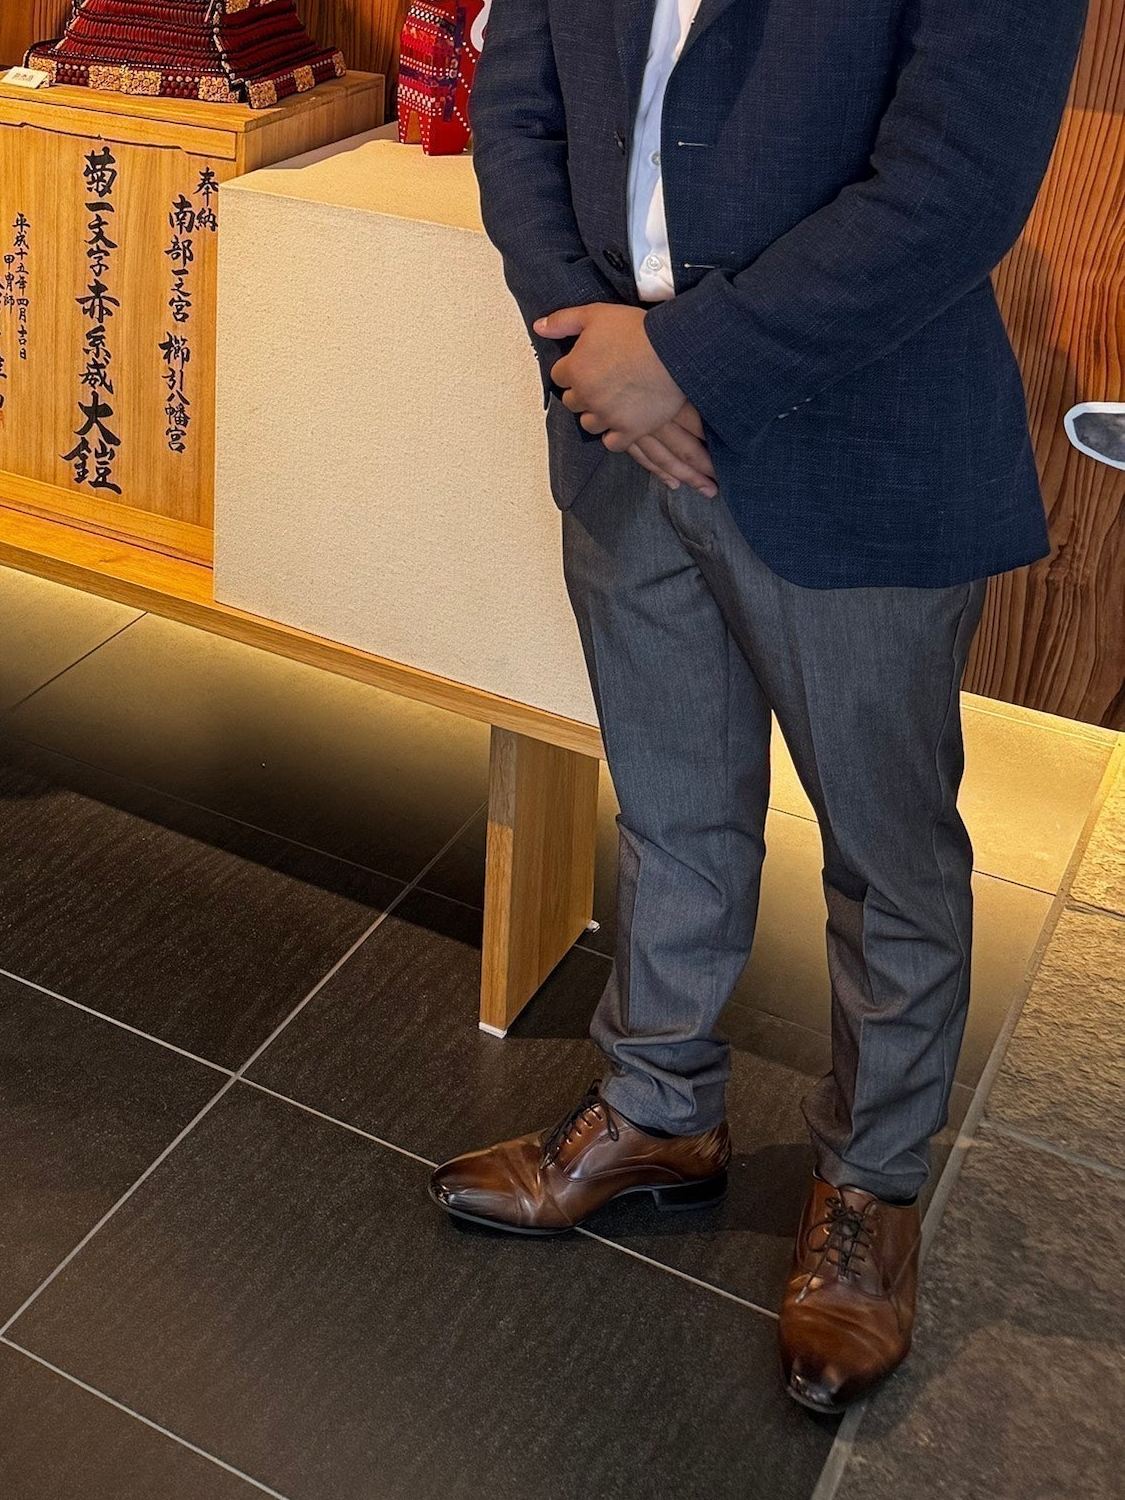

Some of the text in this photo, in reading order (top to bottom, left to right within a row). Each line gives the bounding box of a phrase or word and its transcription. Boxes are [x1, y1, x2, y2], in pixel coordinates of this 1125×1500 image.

[193, 167, 219, 232] 奉納
[12, 212, 31, 360] 平成十五年四月吉日
